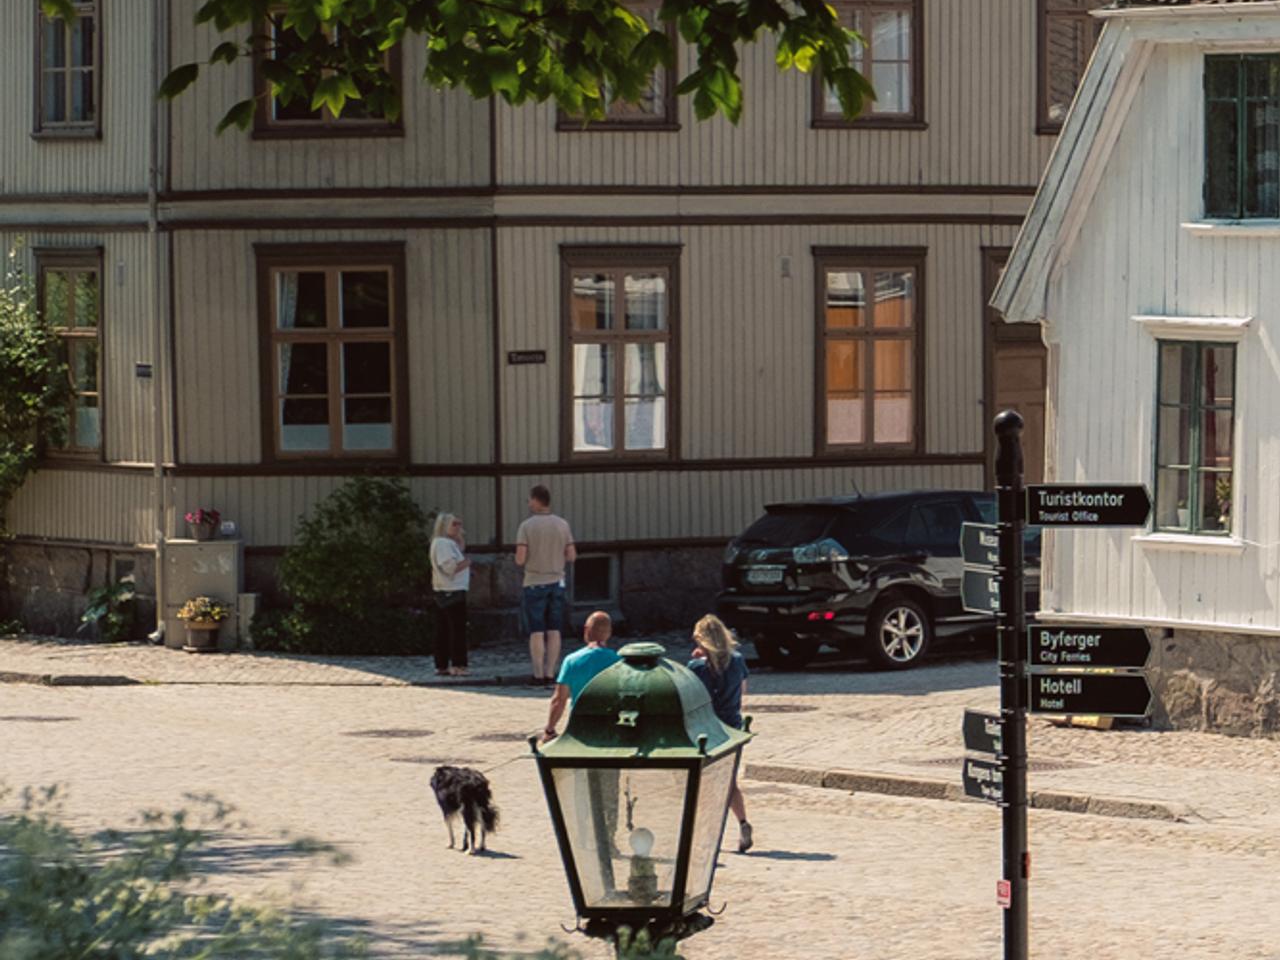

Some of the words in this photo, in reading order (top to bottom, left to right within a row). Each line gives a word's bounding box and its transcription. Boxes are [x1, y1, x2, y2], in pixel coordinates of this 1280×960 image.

[1038, 491, 1125, 507] Turistkontor
[1039, 510, 1069, 521] Tourist
[1072, 510, 1099, 521] Office
[1040, 631, 1101, 650] Byferger
[1040, 651, 1058, 663] City
[1061, 651, 1091, 662] Ferries
[1040, 679, 1082, 694] Hotell
[1040, 699, 1064, 709] Hotel
